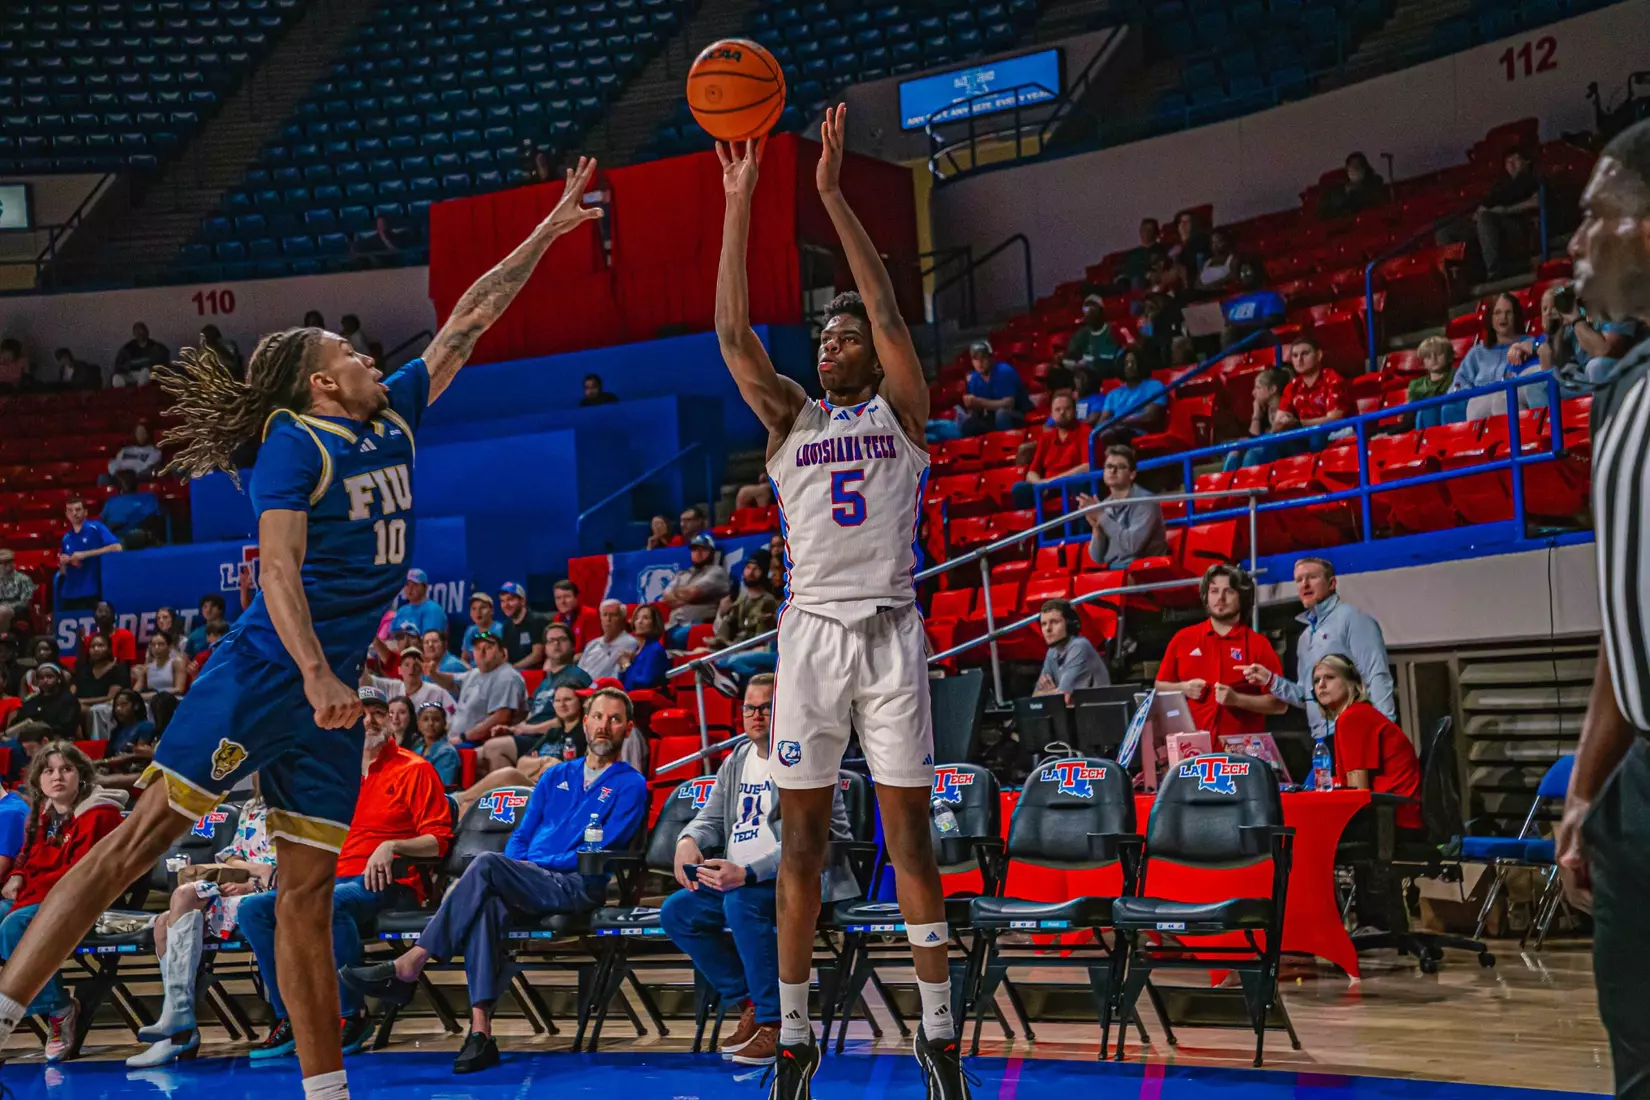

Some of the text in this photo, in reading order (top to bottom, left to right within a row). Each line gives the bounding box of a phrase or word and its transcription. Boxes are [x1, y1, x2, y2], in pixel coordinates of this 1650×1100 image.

[1499, 36, 1558, 81] 112
[191, 289, 235, 316] 110
[796, 435, 897, 467] LOUISIANA TECH
[343, 463, 412, 521] FIU
[830, 468, 867, 527] 5
[373, 518, 406, 565] 10
[58, 608, 200, 650] STDET
[733, 828, 759, 843] TECH
